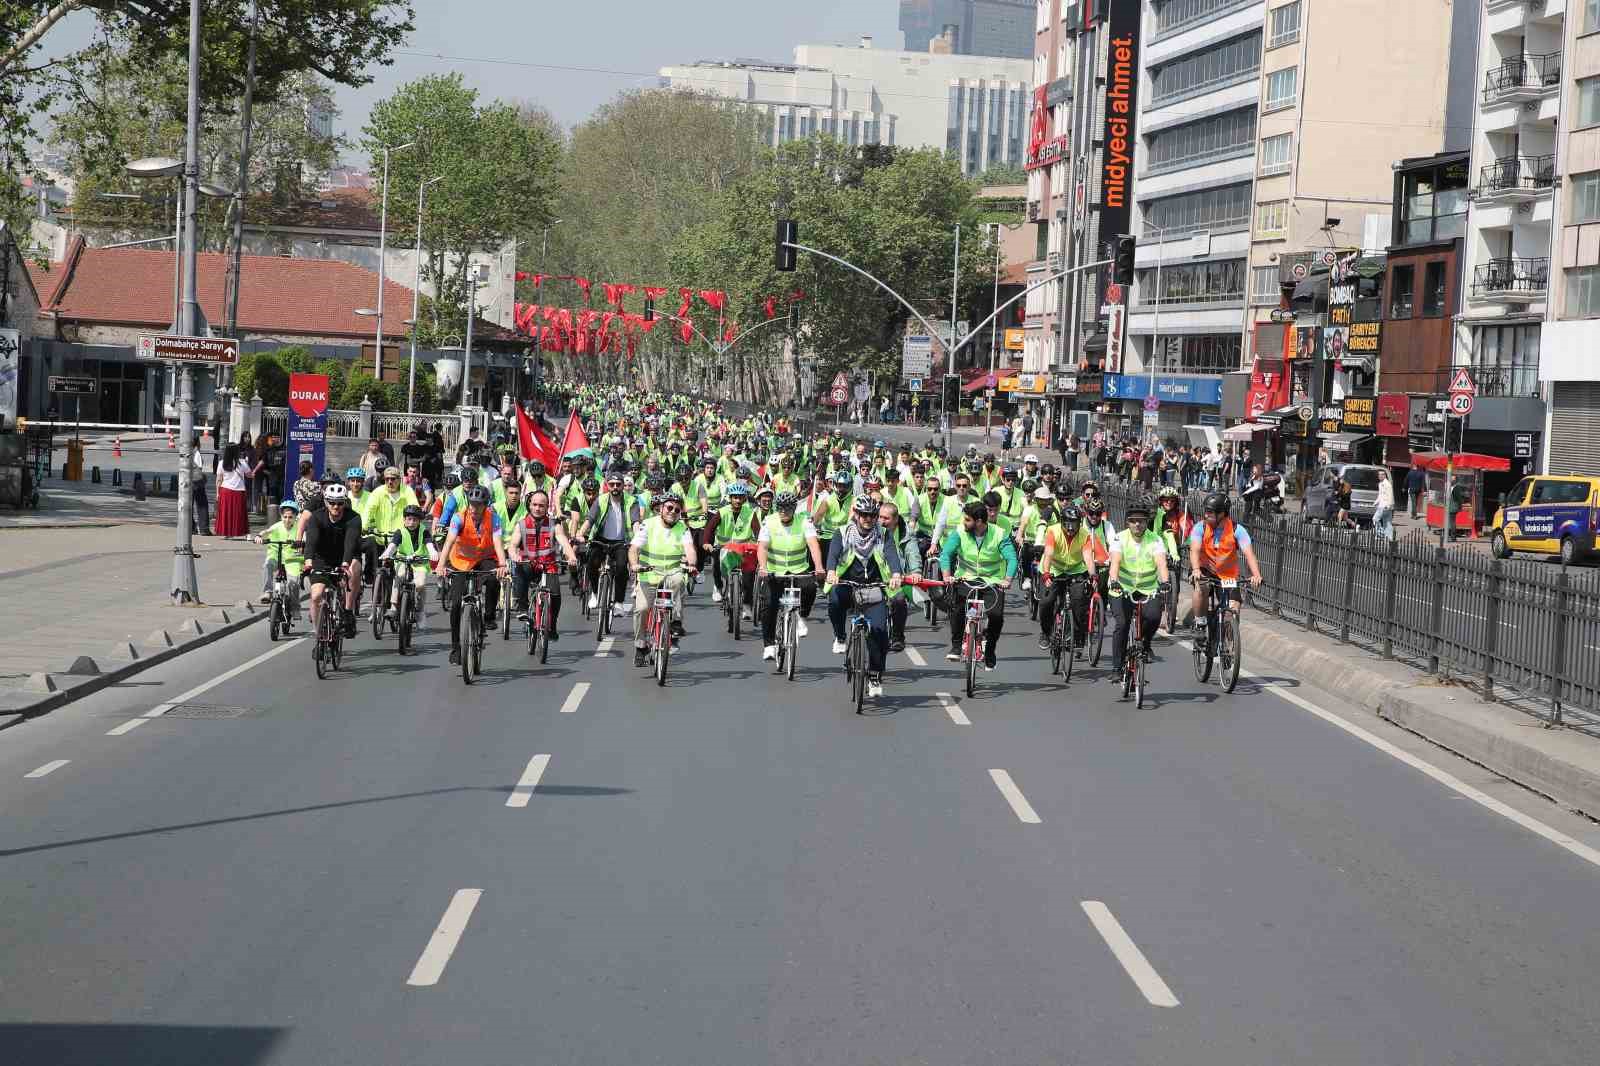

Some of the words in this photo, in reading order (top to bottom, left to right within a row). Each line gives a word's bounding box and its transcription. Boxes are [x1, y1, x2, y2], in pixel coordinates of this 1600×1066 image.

[1104, 117, 1130, 208] midyeci
[155, 337, 199, 350] Dolmabahçe
[200, 340, 224, 352] Sarayı
[291, 391, 326, 401] DURAK
[1456, 398, 1469, 409] 20
